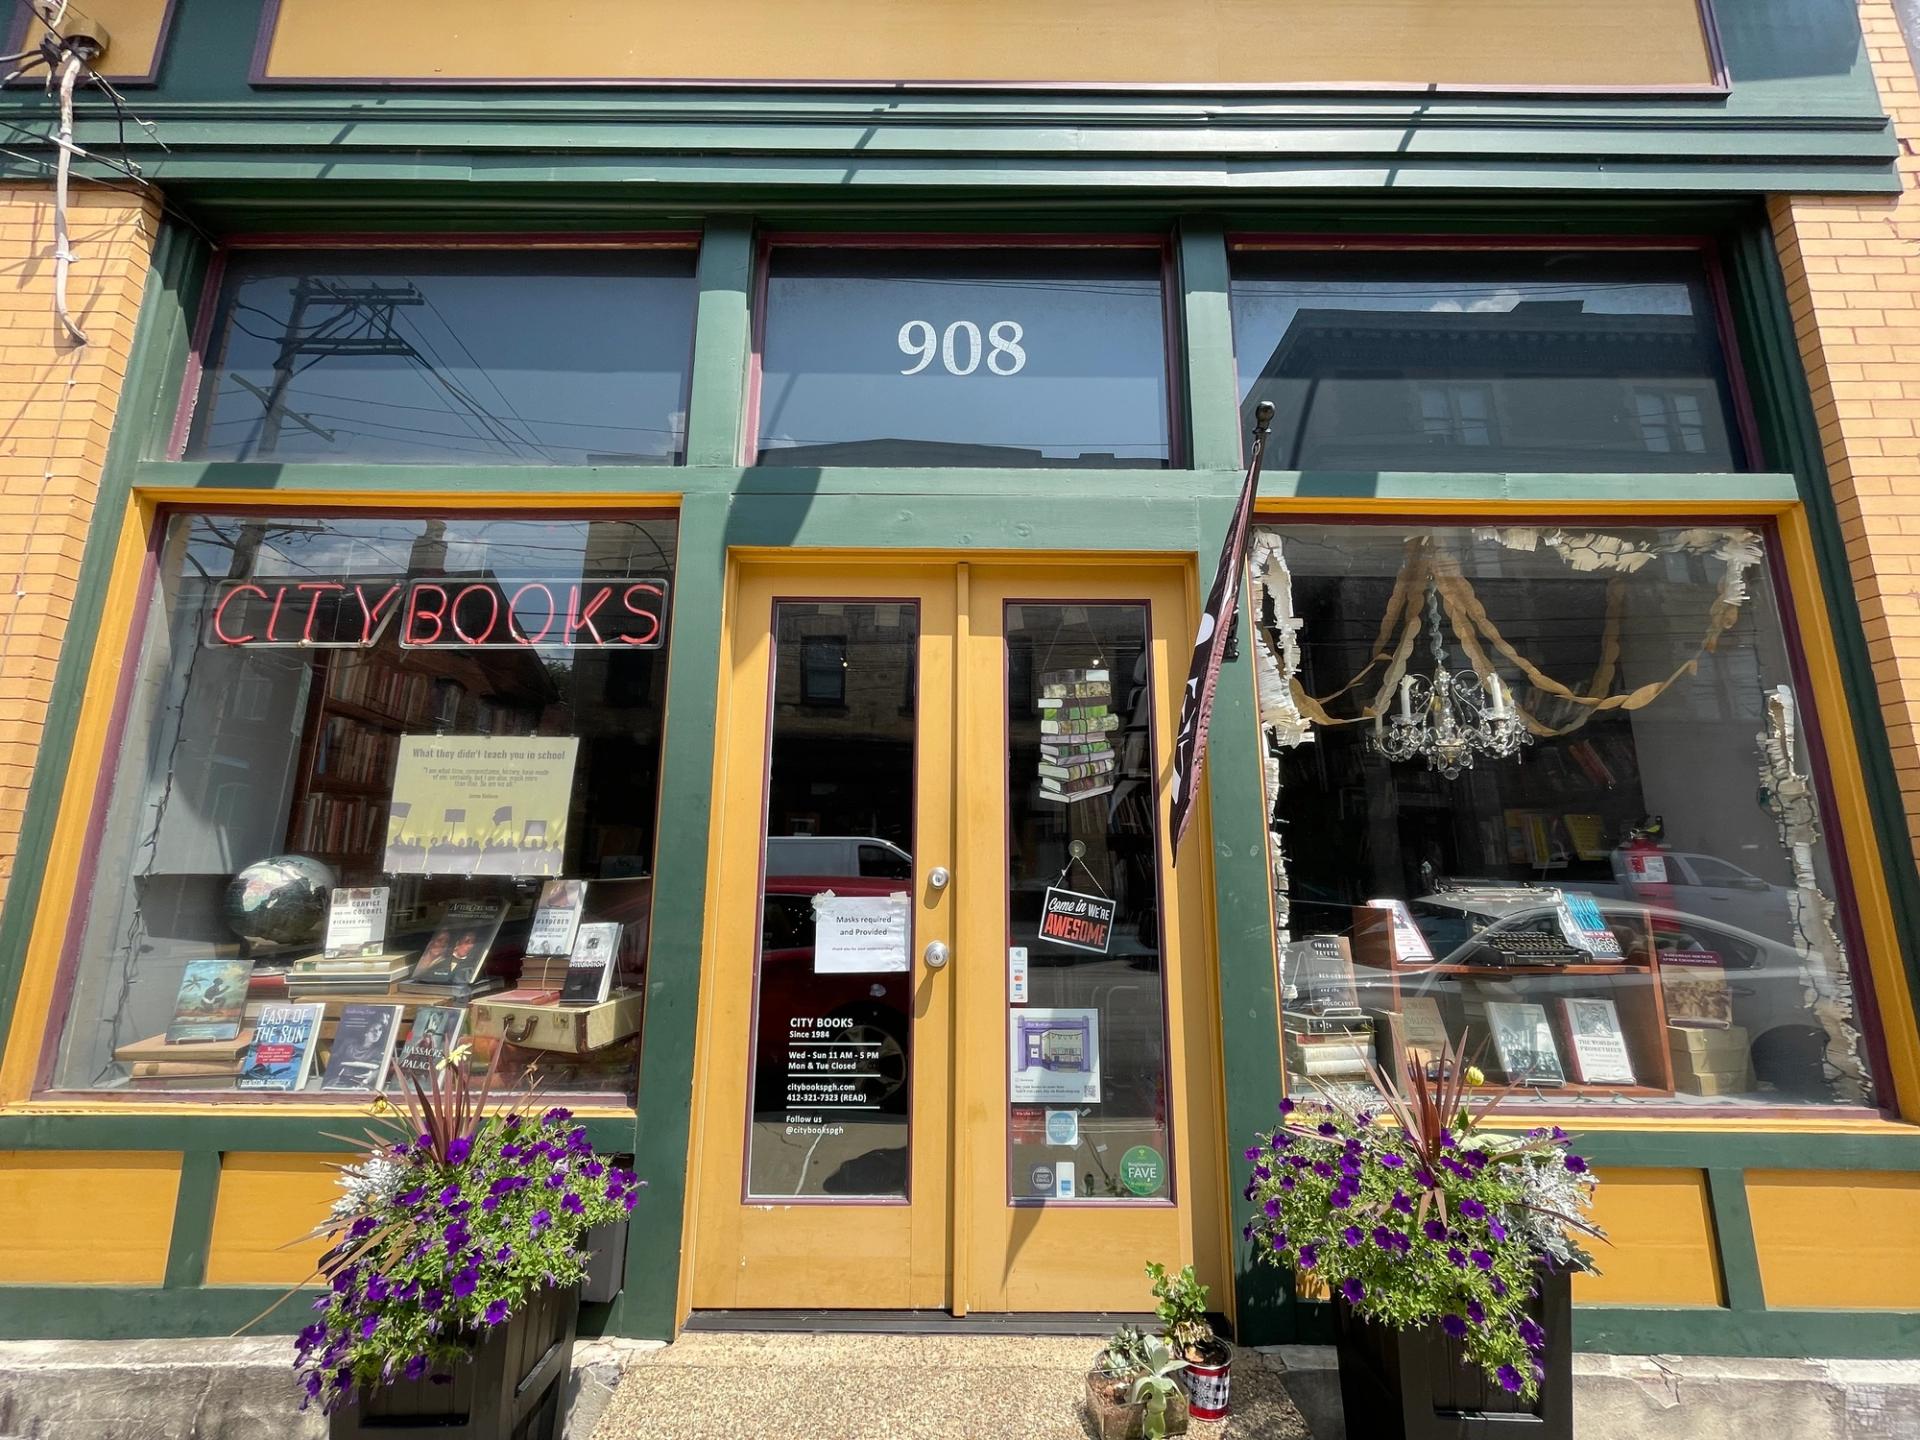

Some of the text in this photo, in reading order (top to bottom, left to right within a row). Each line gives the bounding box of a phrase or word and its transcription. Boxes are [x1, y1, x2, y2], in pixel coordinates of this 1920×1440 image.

[898, 320, 1026, 376] 908
[413, 749, 565, 760] What they didn't teach you in school
[1048, 897, 1111, 920] Come in WE'RE
[861, 916, 892, 924] required
[855, 928, 888, 936] Provided
[1044, 912, 1107, 946] AWESOME
[261, 1005, 310, 1026] EAST OF
[790, 1018, 854, 1028] CITY BOOKS
[254, 1025, 308, 1043] THE SUN
[403, 1046, 443, 1058] MASSACRE
[788, 1051, 806, 1059] Wed
[812, 1051, 827, 1059] Sun
[401, 1059, 431, 1070] PALAC
[831, 1062, 857, 1070] Closed
[787, 1083, 856, 1092] citybookspgh.com
[786, 1093, 867, 1103] 412-321-7323 (READ)
[786, 1115, 812, 1123] Follow
[786, 1126, 844, 1135] @citybookspgh
[1128, 1167, 1157, 1178] FAVE
